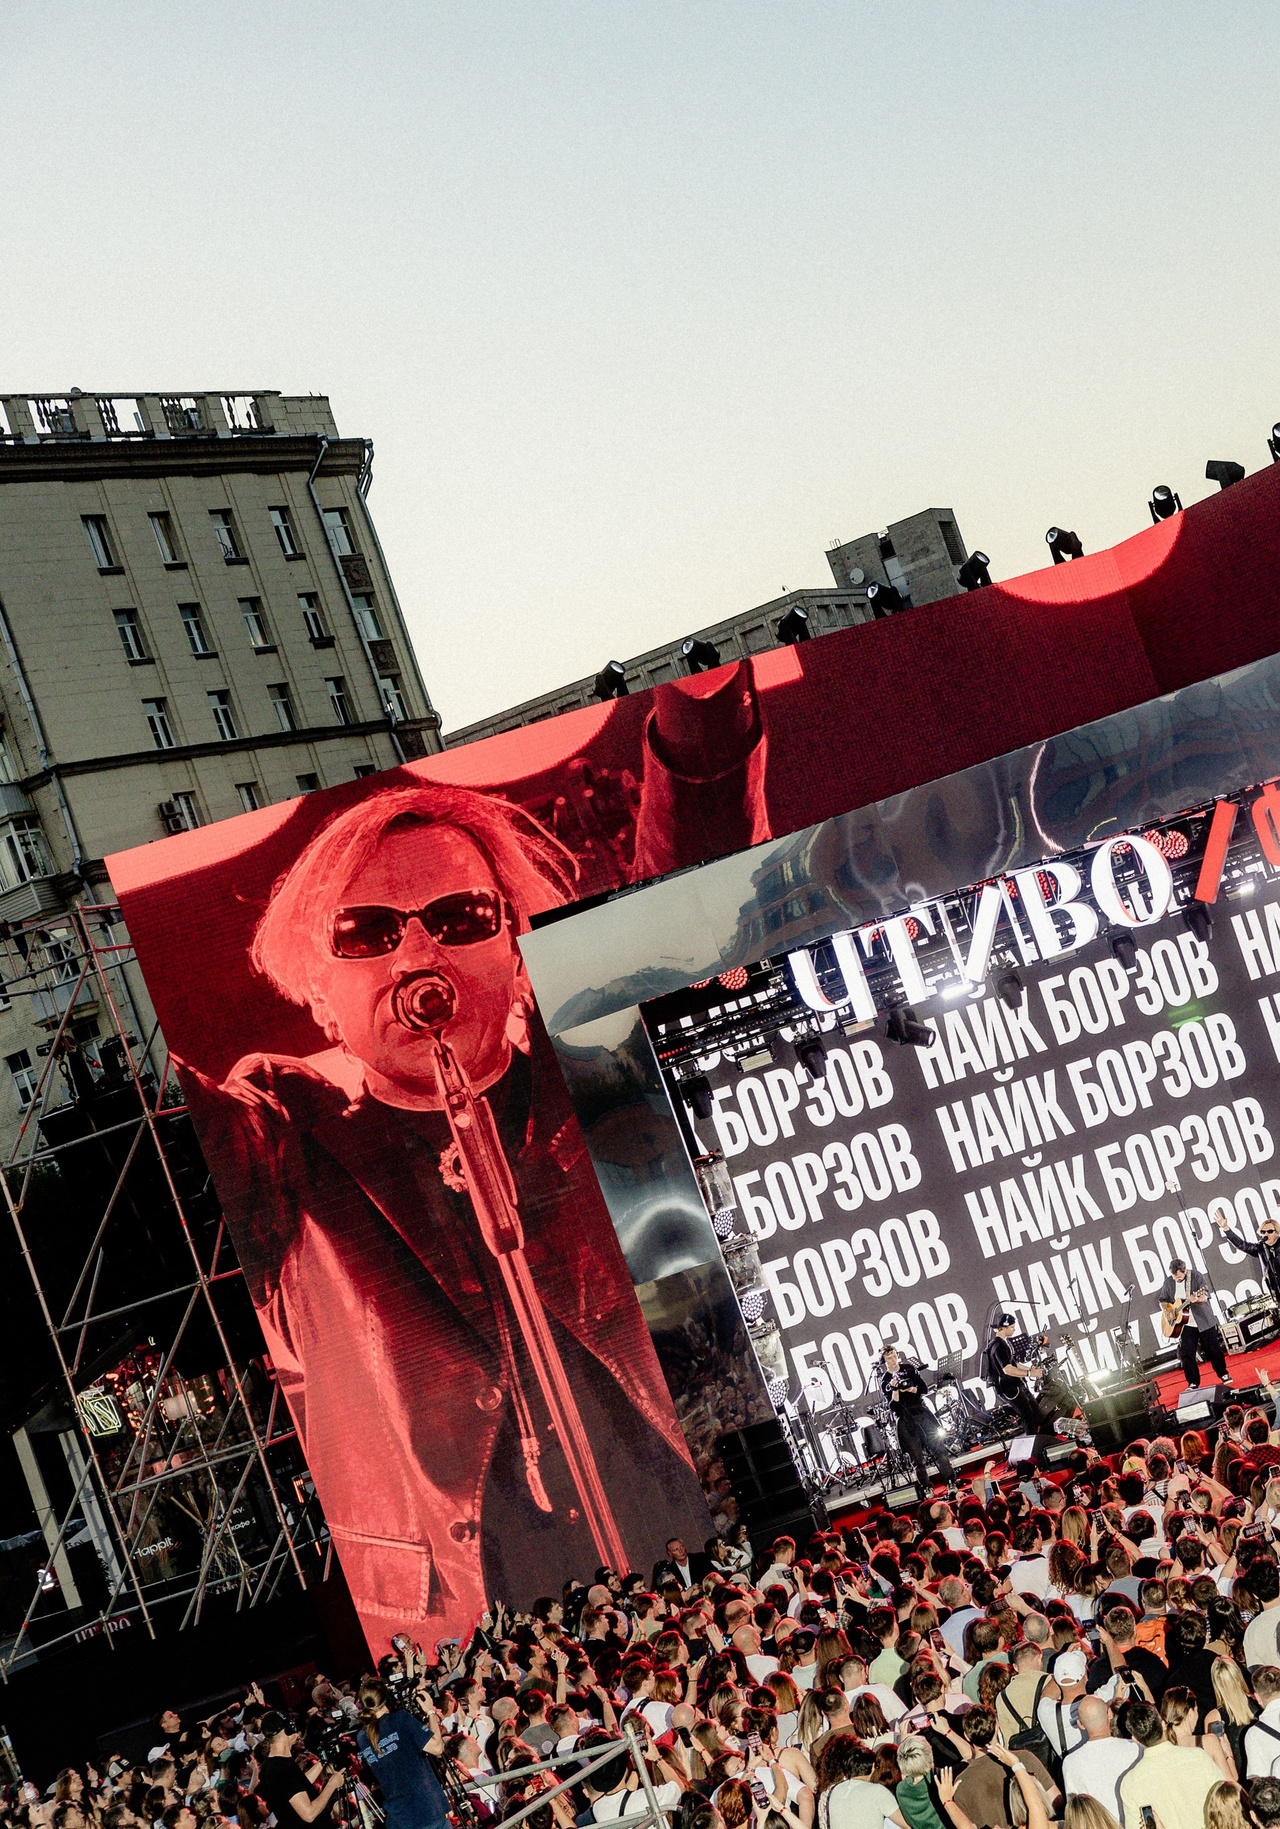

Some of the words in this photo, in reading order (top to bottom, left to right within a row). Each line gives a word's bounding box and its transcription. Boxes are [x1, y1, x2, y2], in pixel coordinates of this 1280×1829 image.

[788, 835, 1173, 1022] ЧТИВО
[711, 1040, 894, 1158] БОРЗОВ
[914, 984, 1048, 1090] НАЙК
[1038, 930, 1219, 1046] БОРЗОВ
[732, 1123, 922, 1240] БОРЗОВ
[935, 1066, 1076, 1174] НАЙК
[1065, 1012, 1246, 1129] БОРЗОВ
[763, 1209, 951, 1330] БОРЗОВ
[963, 1151, 1105, 1259] НАЙК
[1094, 1096, 1275, 1214] БОРЗОВ
[789, 1292, 978, 1413] БОРЗОВ
[991, 1234, 1131, 1337] НАЙК
